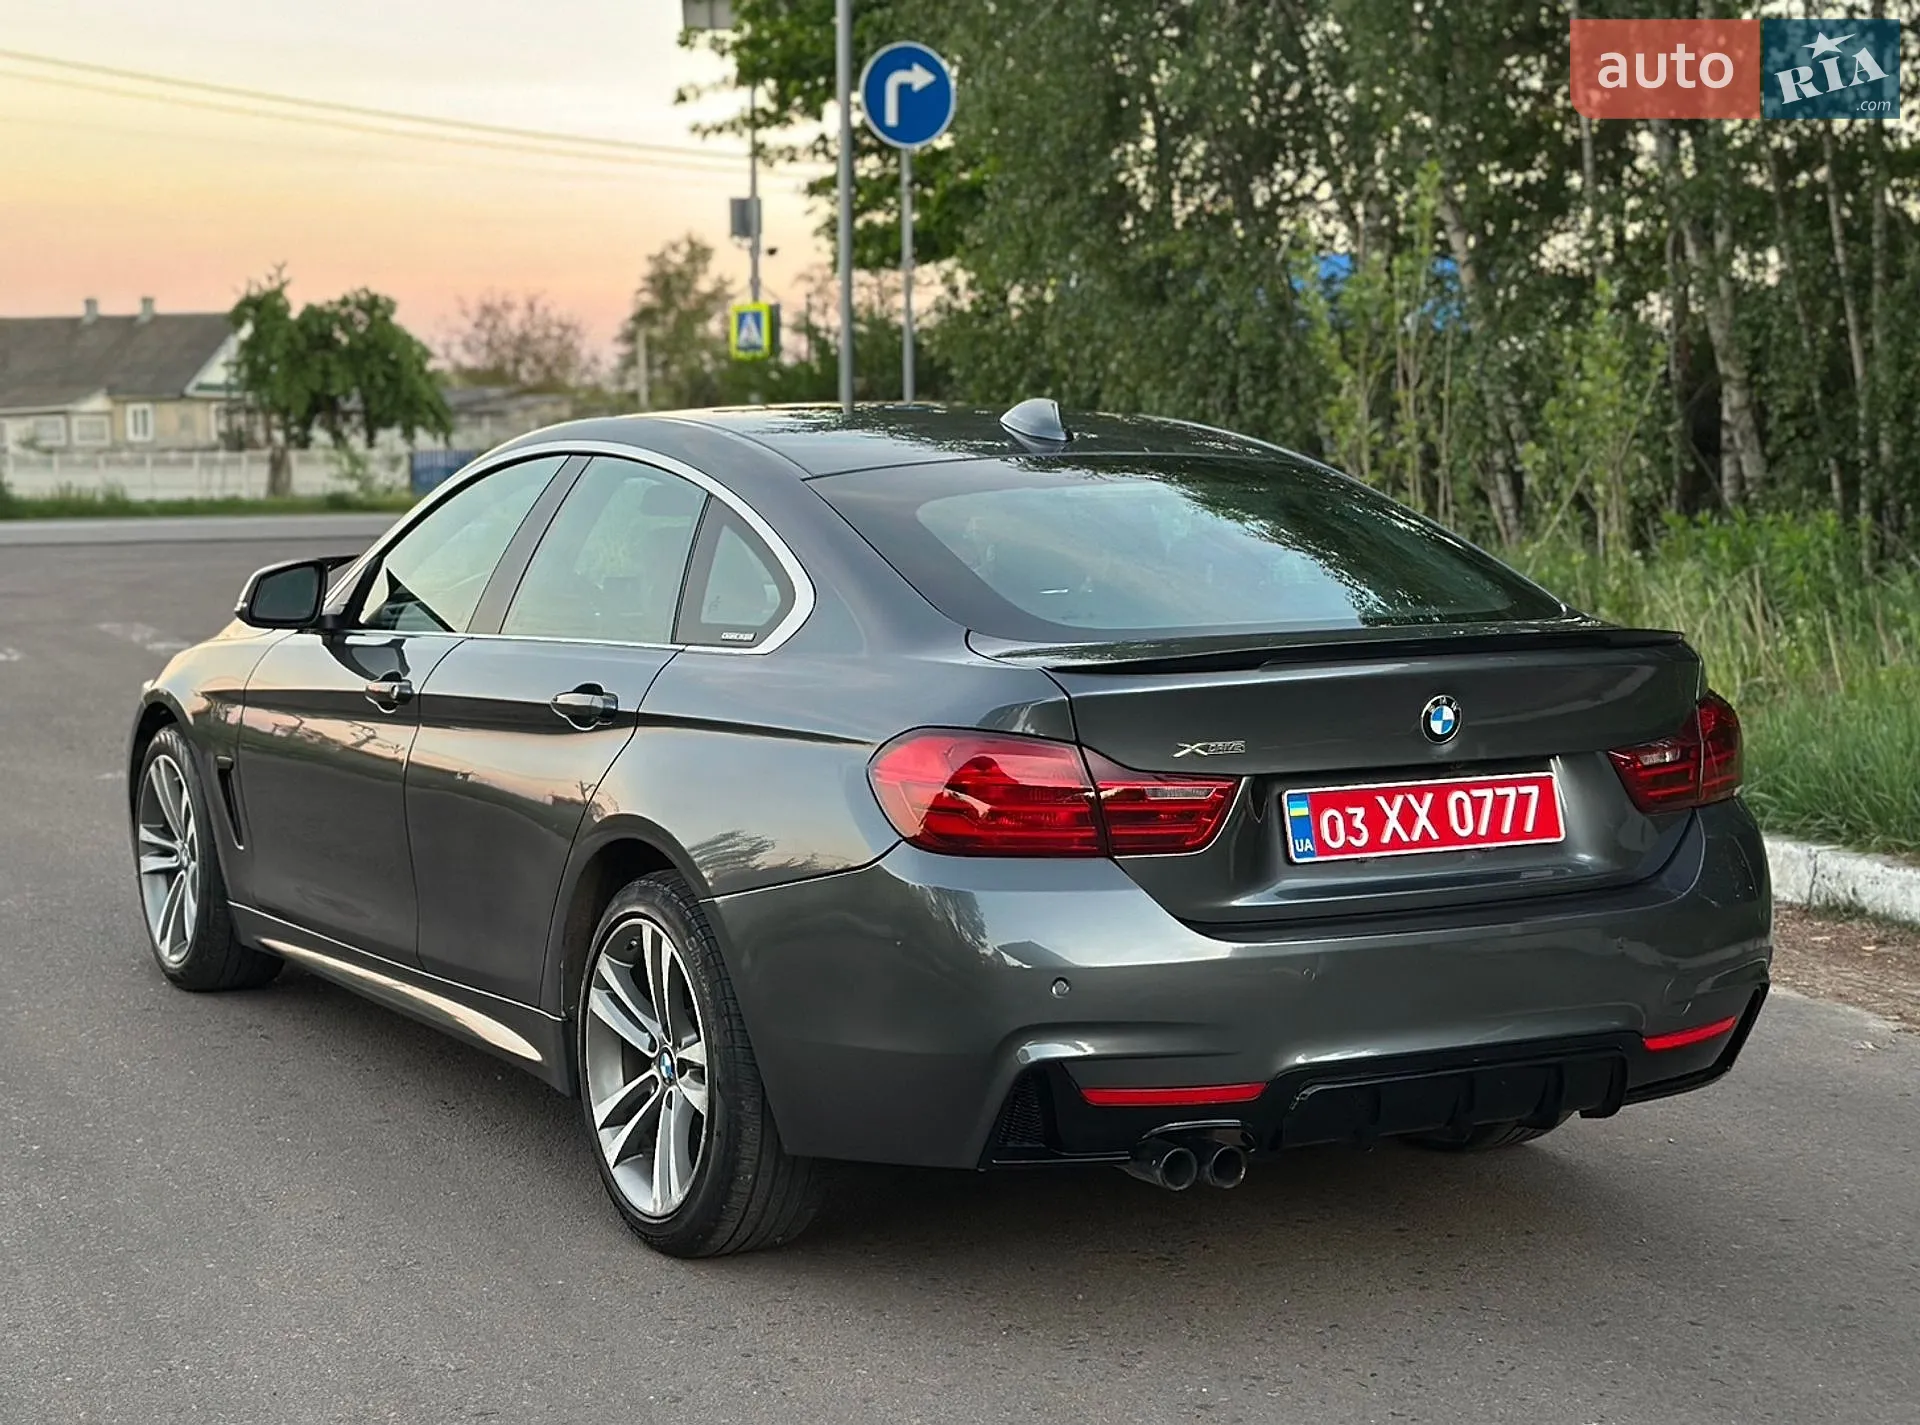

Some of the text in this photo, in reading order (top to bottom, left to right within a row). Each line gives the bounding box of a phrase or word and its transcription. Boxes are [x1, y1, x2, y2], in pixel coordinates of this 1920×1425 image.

[1319, 784, 1540, 849] 03 XX 0777
[1294, 838, 1314, 852] UA
